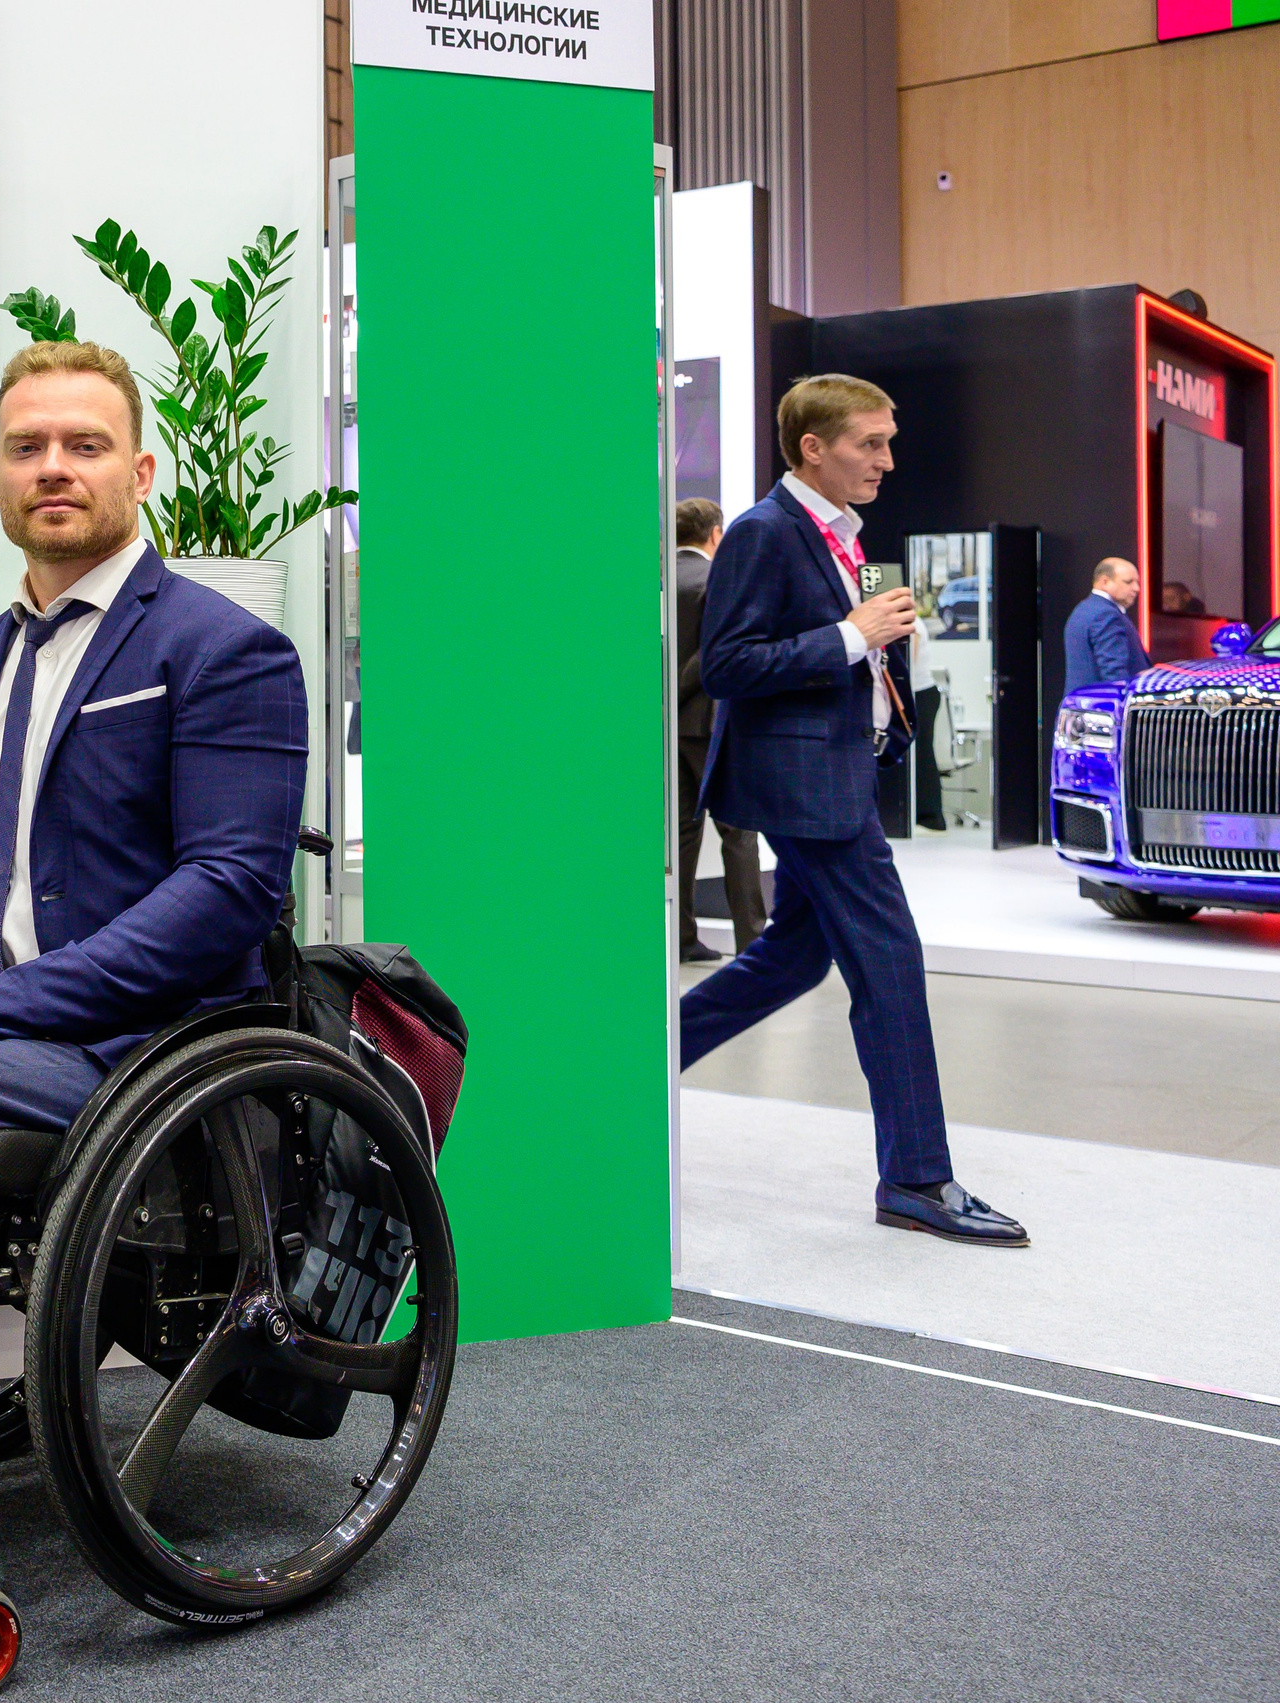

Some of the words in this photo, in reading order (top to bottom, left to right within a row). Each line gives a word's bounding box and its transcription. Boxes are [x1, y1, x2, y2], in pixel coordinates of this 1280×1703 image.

[412, 0, 600, 31] МЕДИЦИНСКИЕ
[426, 25, 588, 60] ТЕХНОЛОГИИ
[325, 1189, 413, 1277] 113
[185, 1610, 246, 1624] SENTINEL
